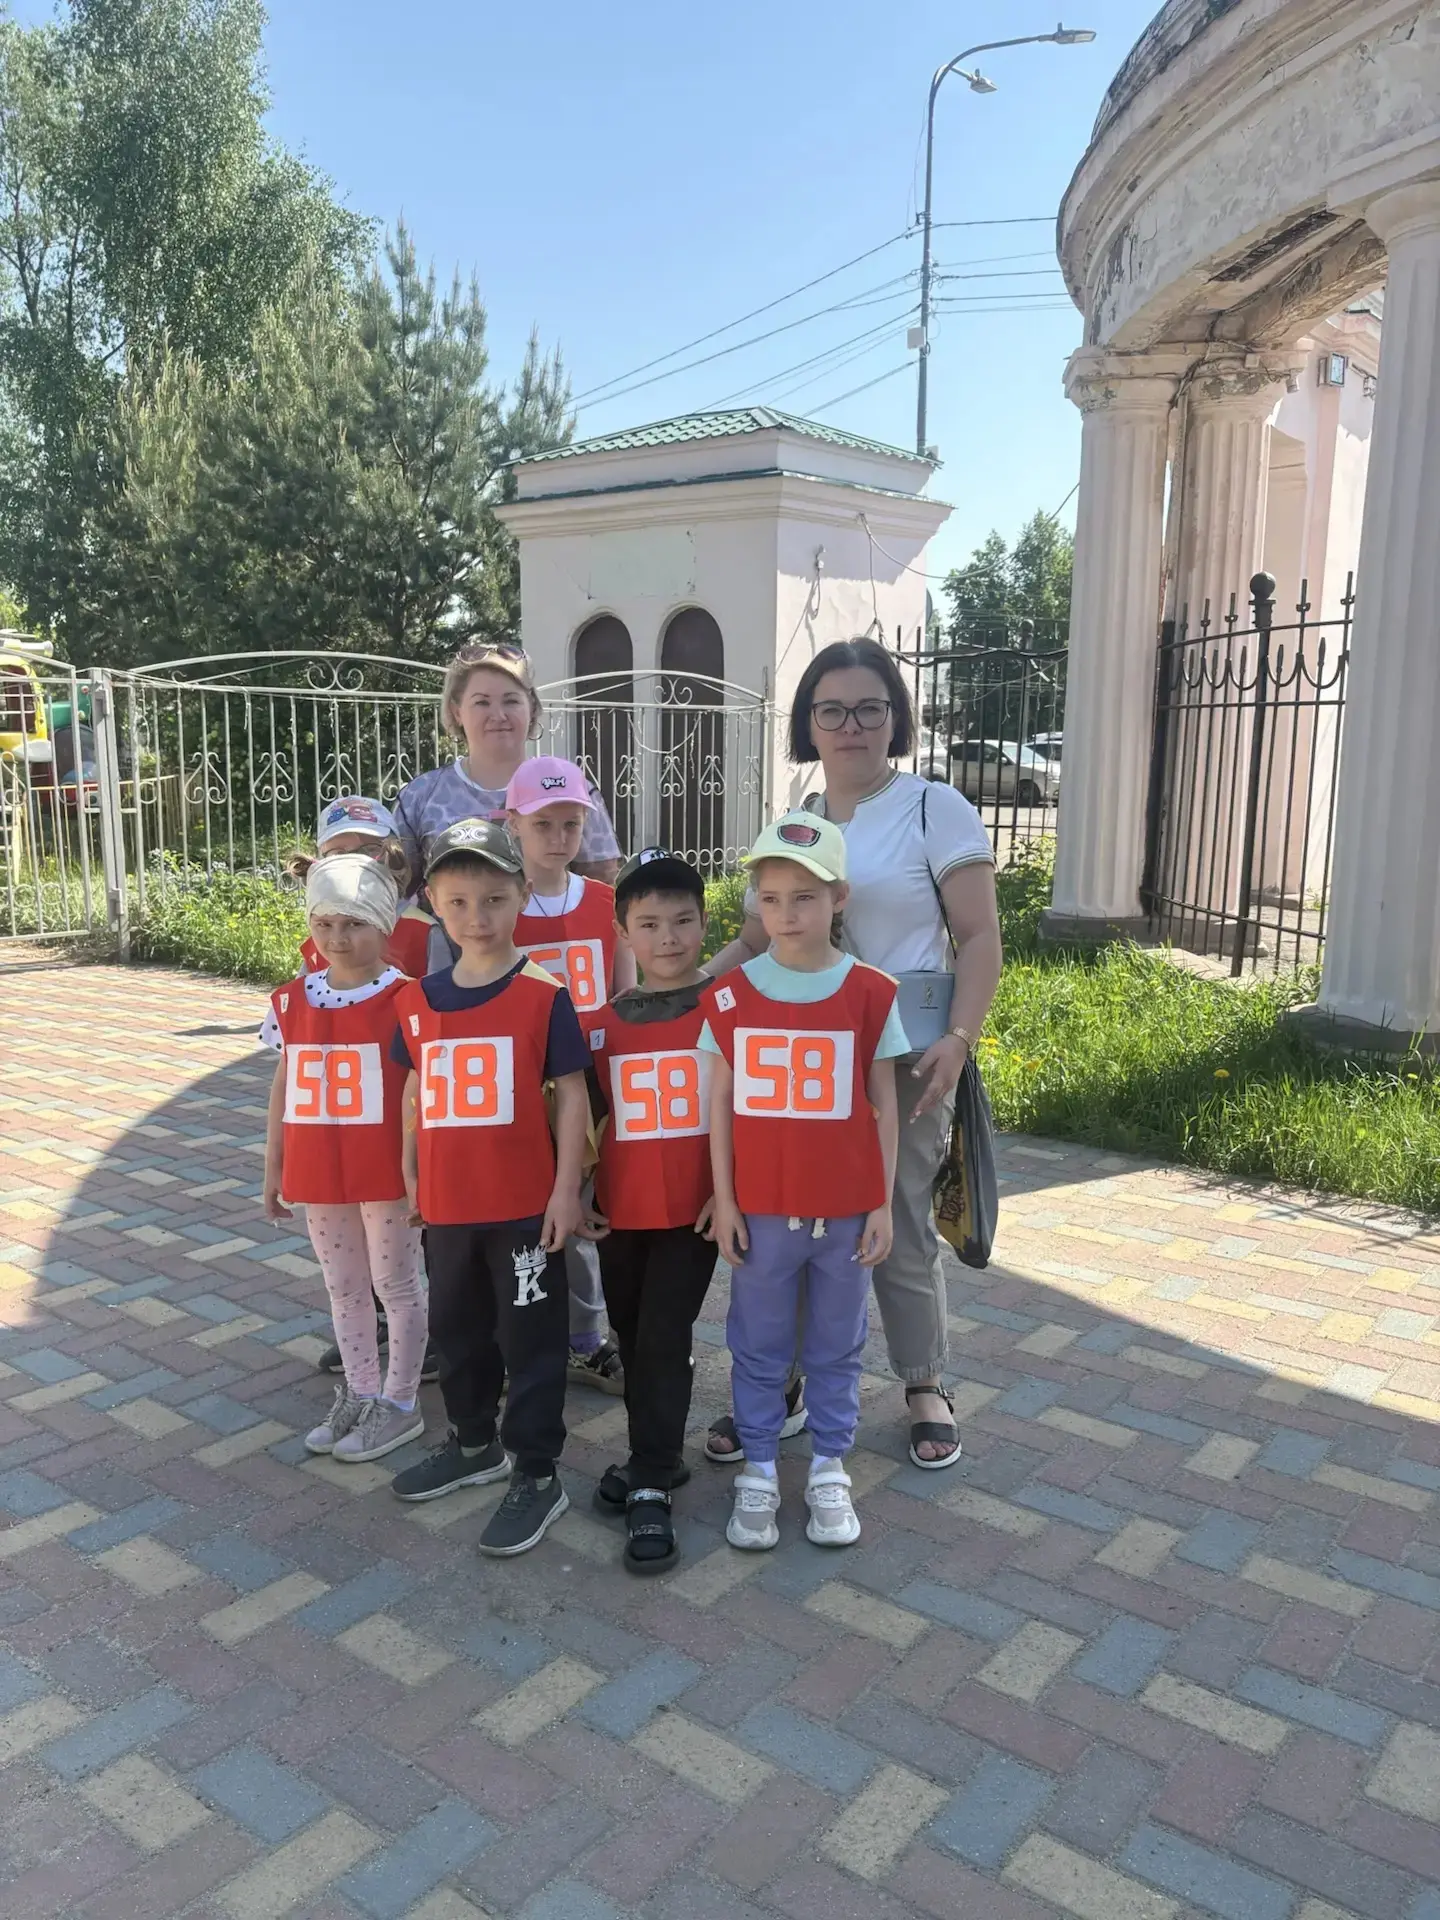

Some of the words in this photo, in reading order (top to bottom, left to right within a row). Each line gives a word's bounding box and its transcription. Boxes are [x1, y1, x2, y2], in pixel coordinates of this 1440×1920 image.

[721, 992, 729, 1008] 5
[294, 1050, 363, 1117] 58
[426, 1043, 497, 1119] 58
[620, 1055, 701, 1133] 58
[745, 1035, 836, 1111] 58
[513, 1263, 548, 1306] K
